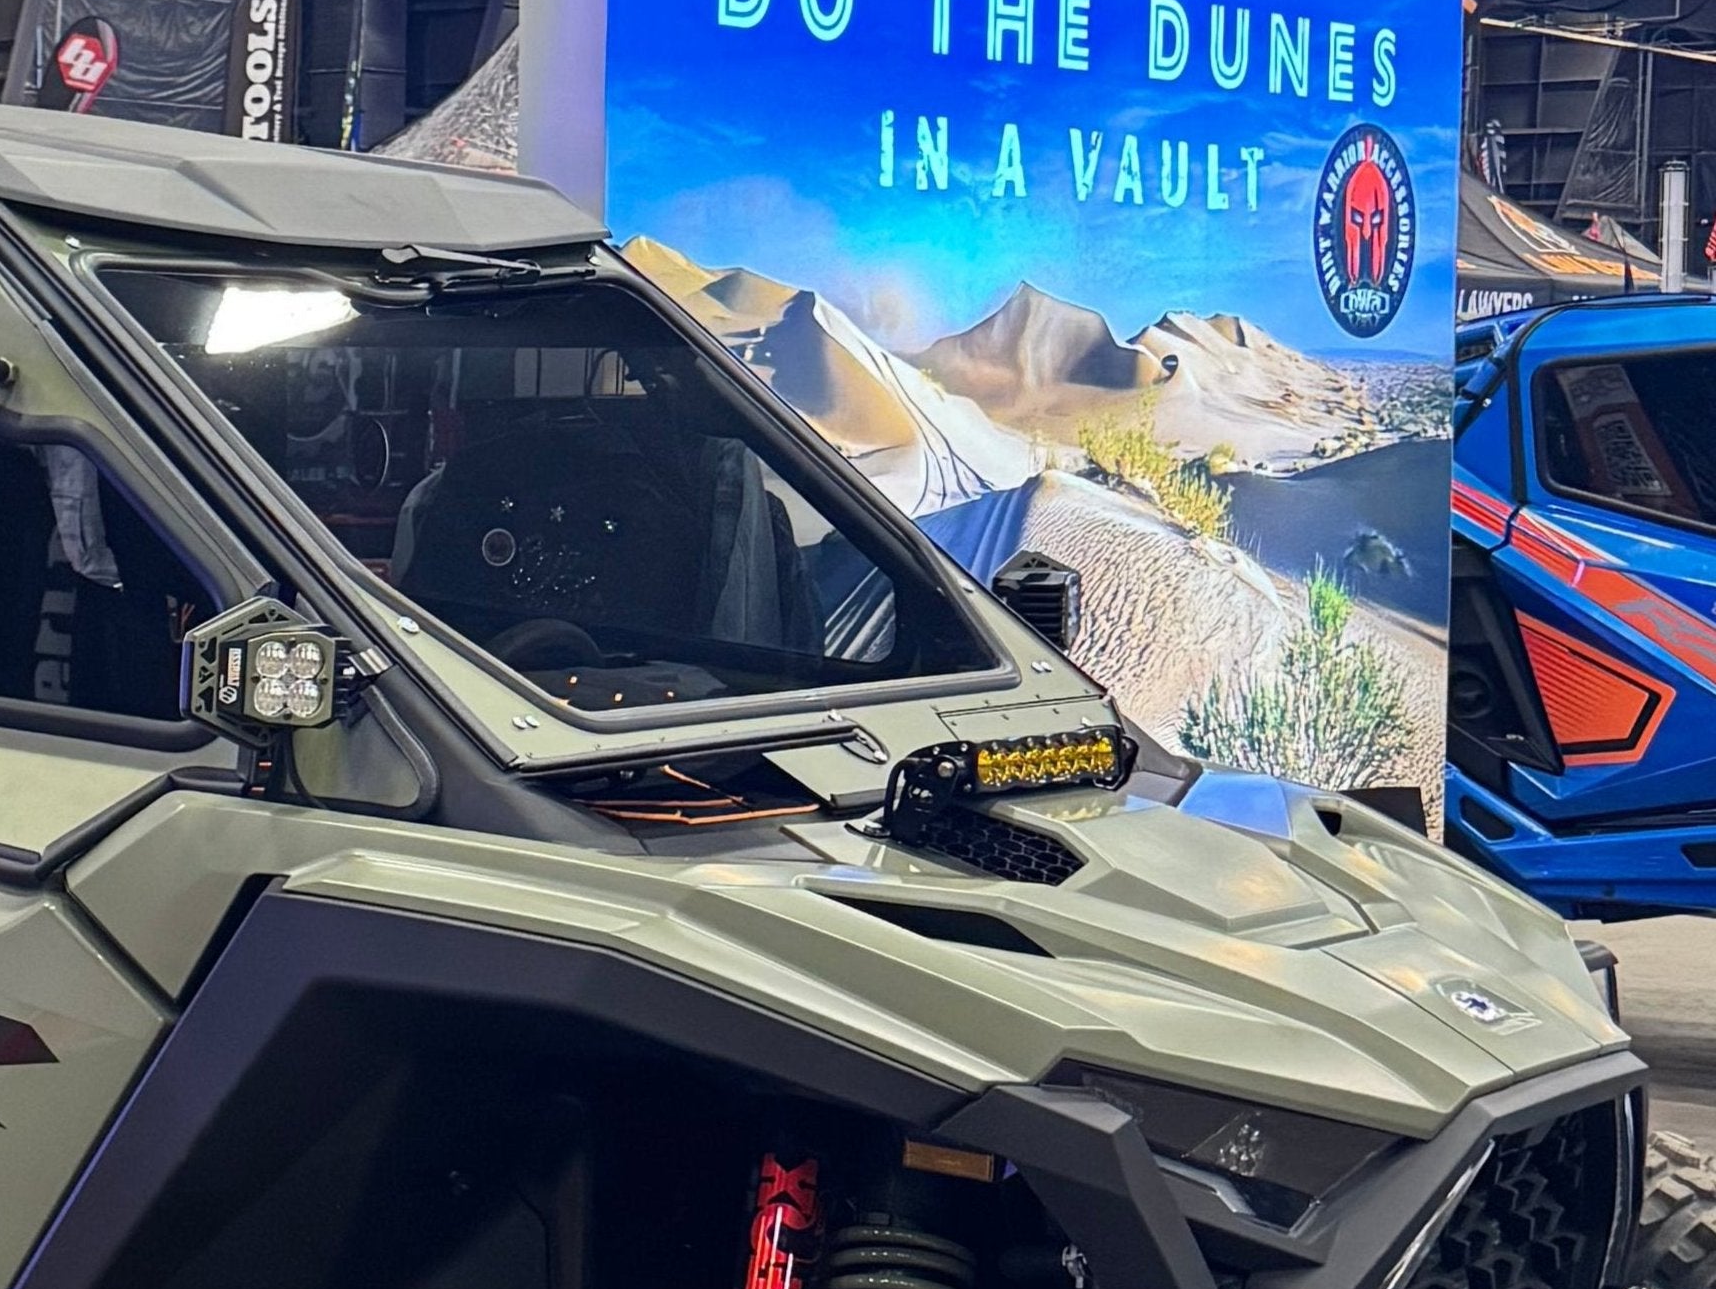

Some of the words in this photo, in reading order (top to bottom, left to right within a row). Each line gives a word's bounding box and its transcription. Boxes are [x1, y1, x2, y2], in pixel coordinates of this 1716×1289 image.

[879, 110, 949, 192] IN
[992, 123, 1027, 198] A
[1069, 128, 1266, 212] VAULT
[1319, 140, 1365, 226] WARRIOR
[1371, 143, 1411, 293] ACCESSORIES
